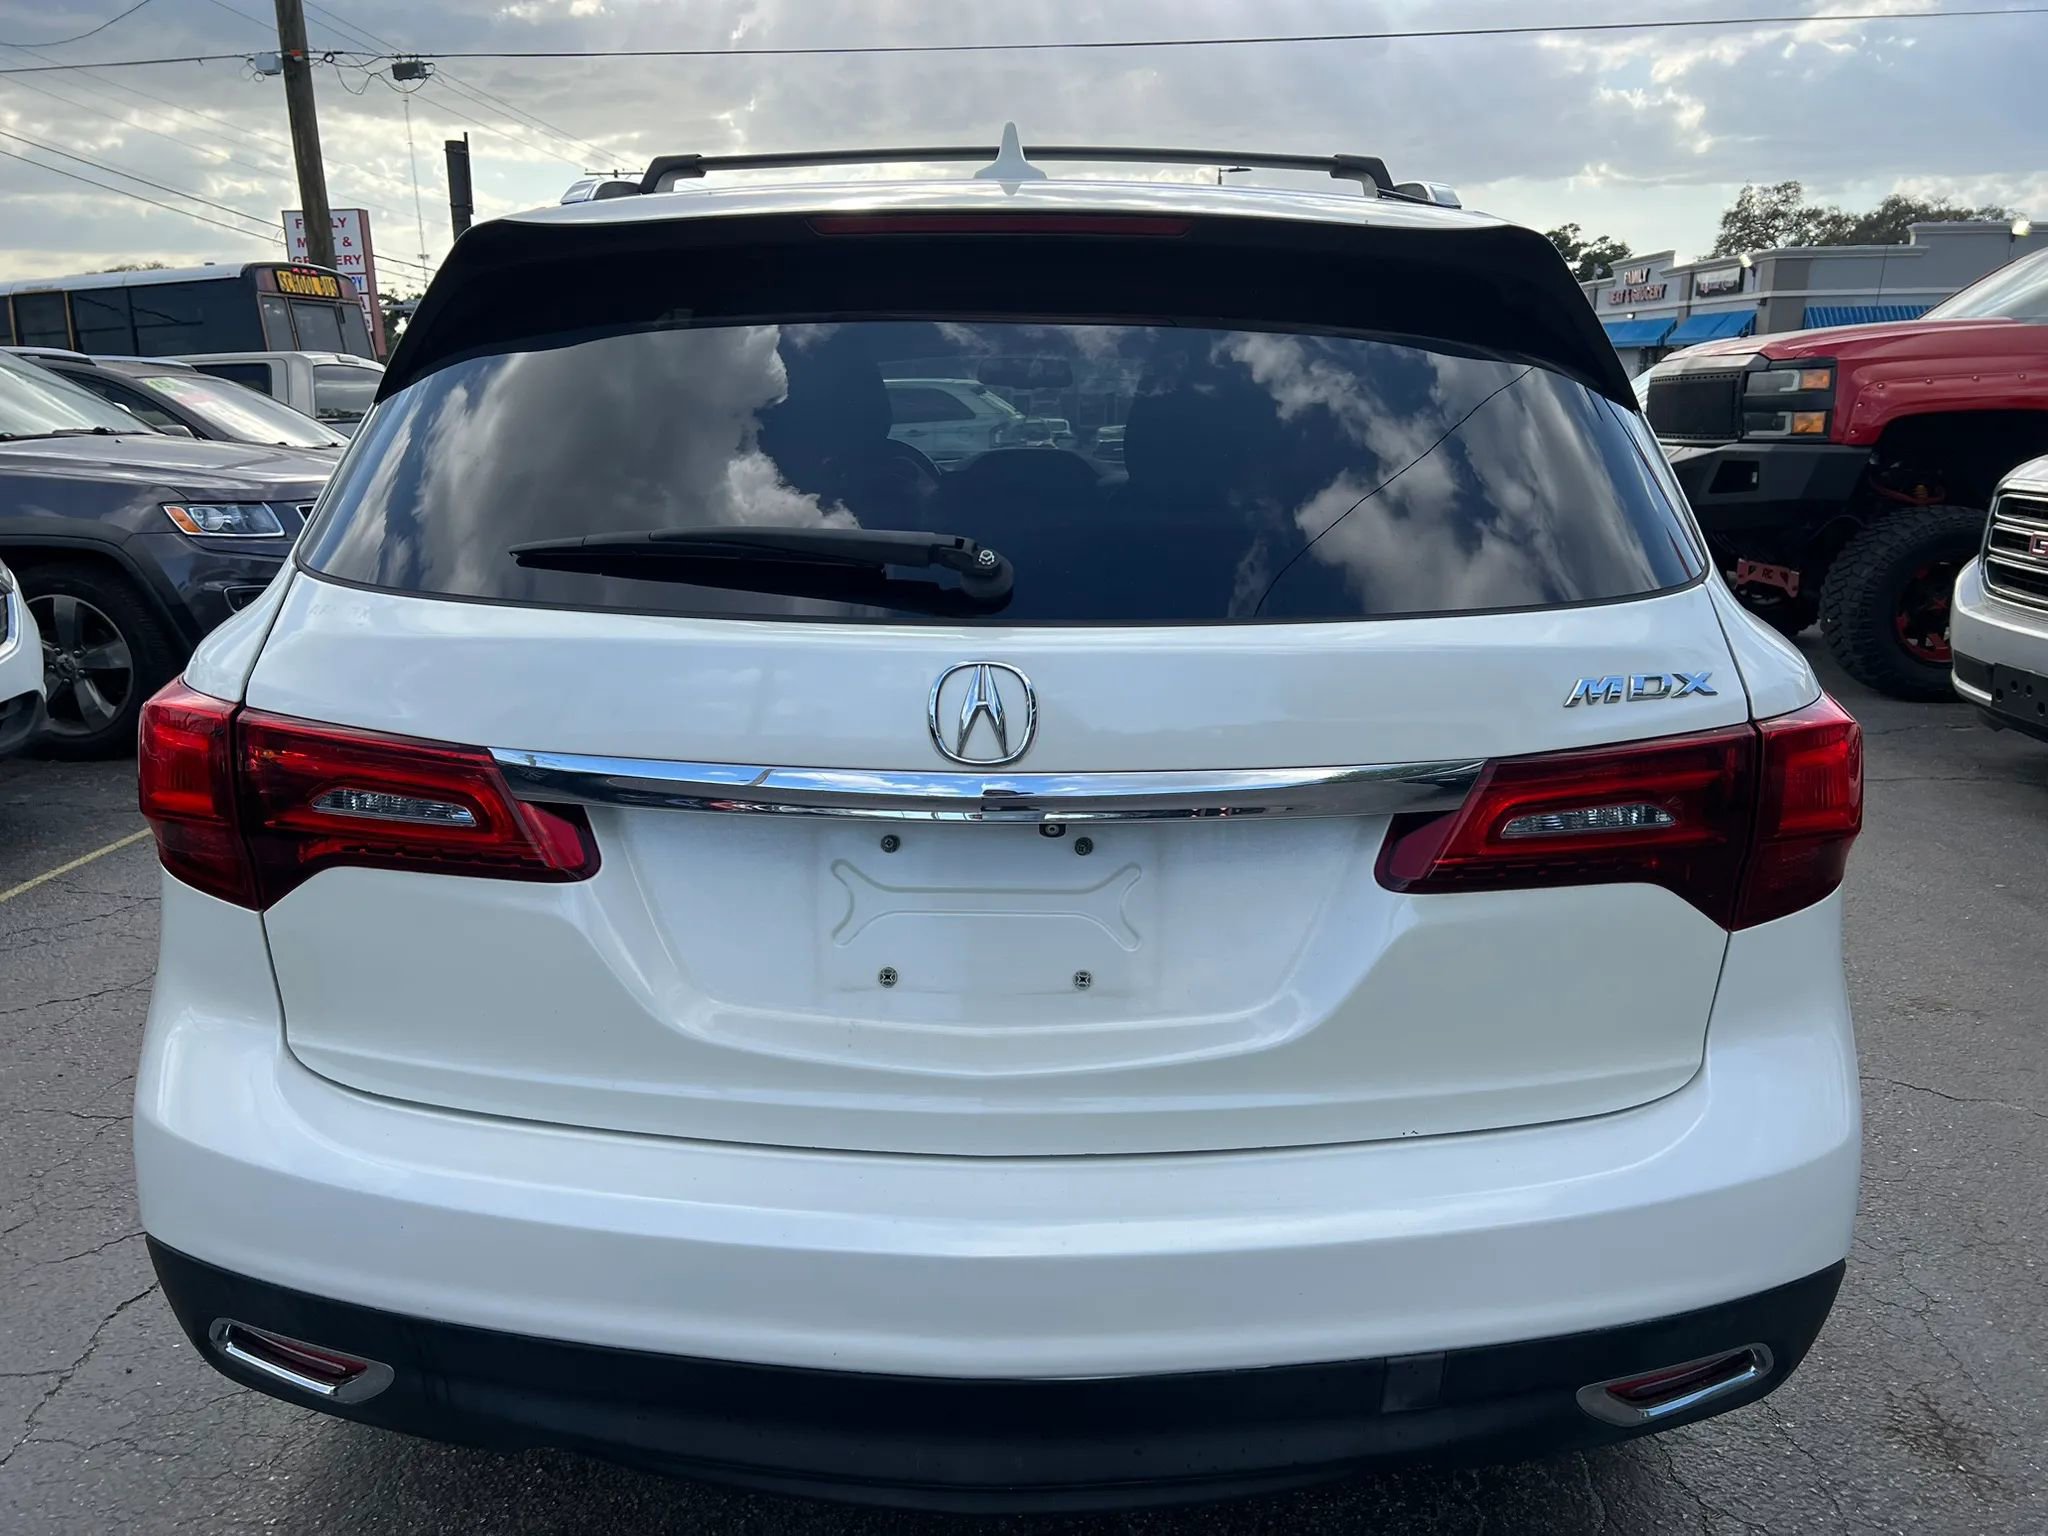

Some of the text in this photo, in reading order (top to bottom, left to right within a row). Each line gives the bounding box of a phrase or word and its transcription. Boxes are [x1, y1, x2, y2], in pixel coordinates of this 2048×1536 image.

[295, 217, 347, 229] FLY
[342, 236, 353, 247] &
[292, 254, 362, 265] GRERY
[278, 272, 318, 295] SCHOOL
[318, 276, 338, 297] BUS
[1563, 671, 1719, 708] MDX
